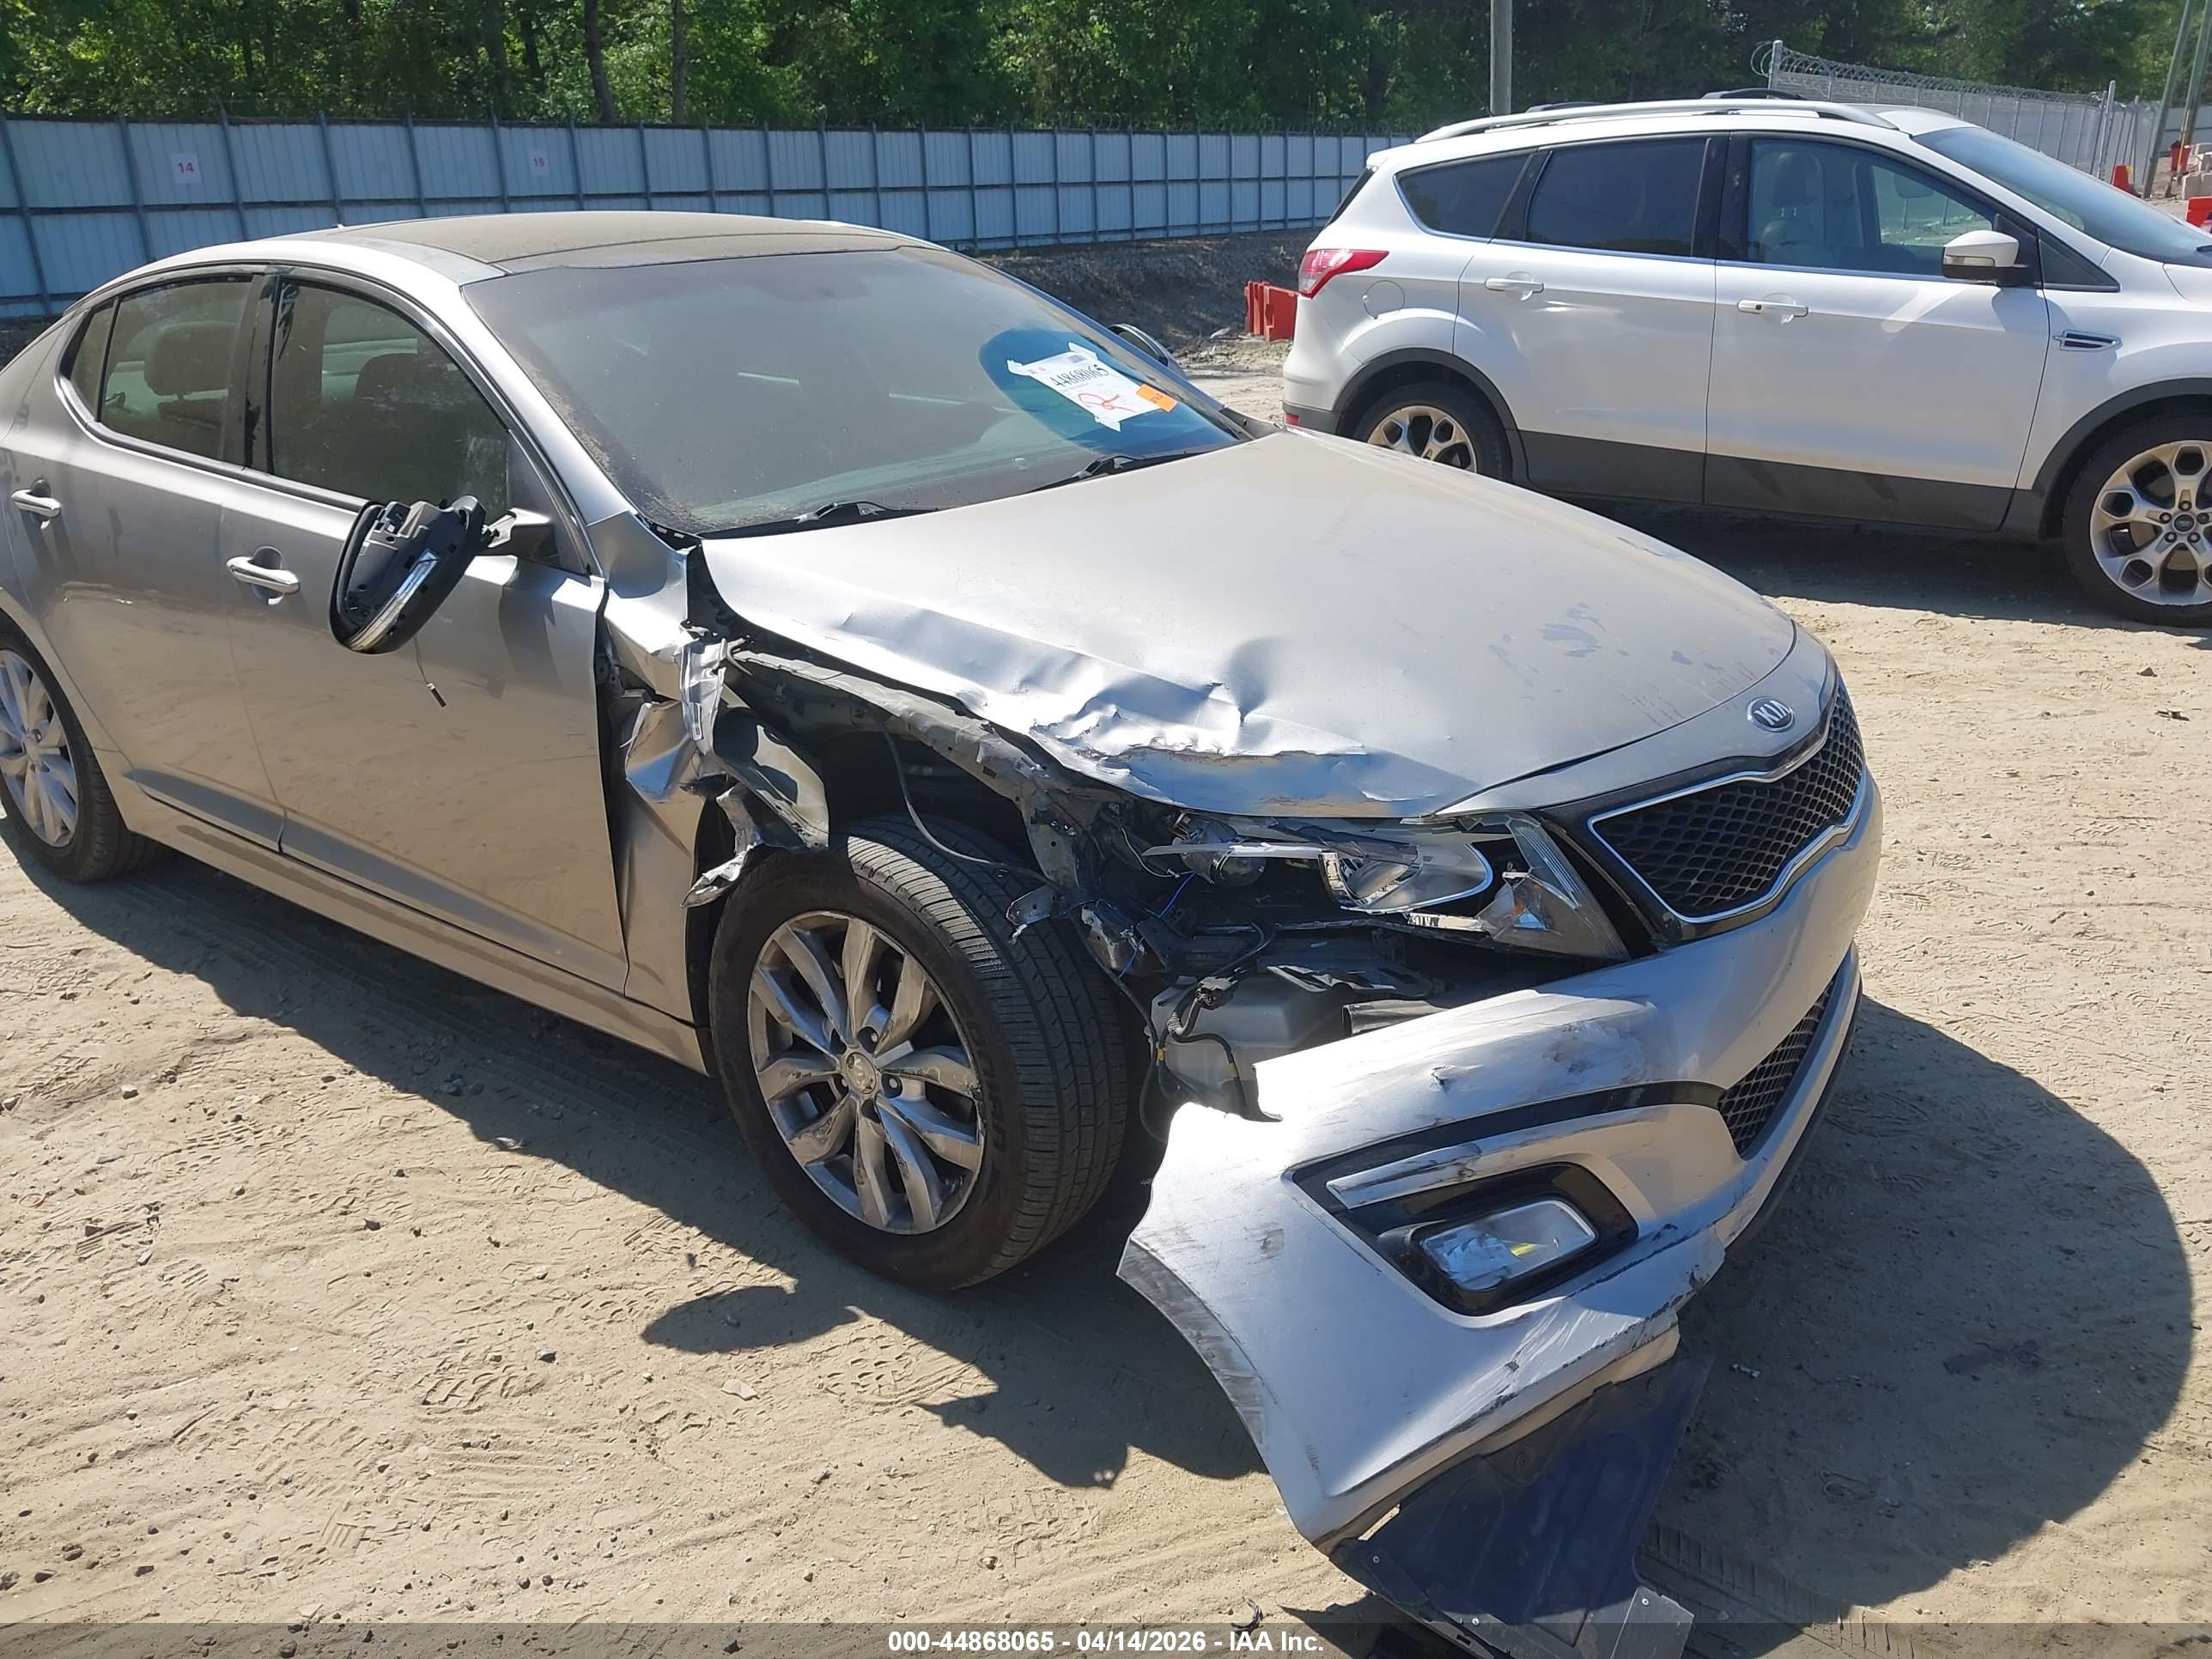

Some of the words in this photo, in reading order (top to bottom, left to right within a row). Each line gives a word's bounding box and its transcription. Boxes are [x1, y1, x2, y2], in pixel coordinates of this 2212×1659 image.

[178, 162, 194, 173] 14
[533, 157, 545, 167] 15
[1049, 364, 1109, 387] 44868065
[1753, 700, 1790, 726] KIA
